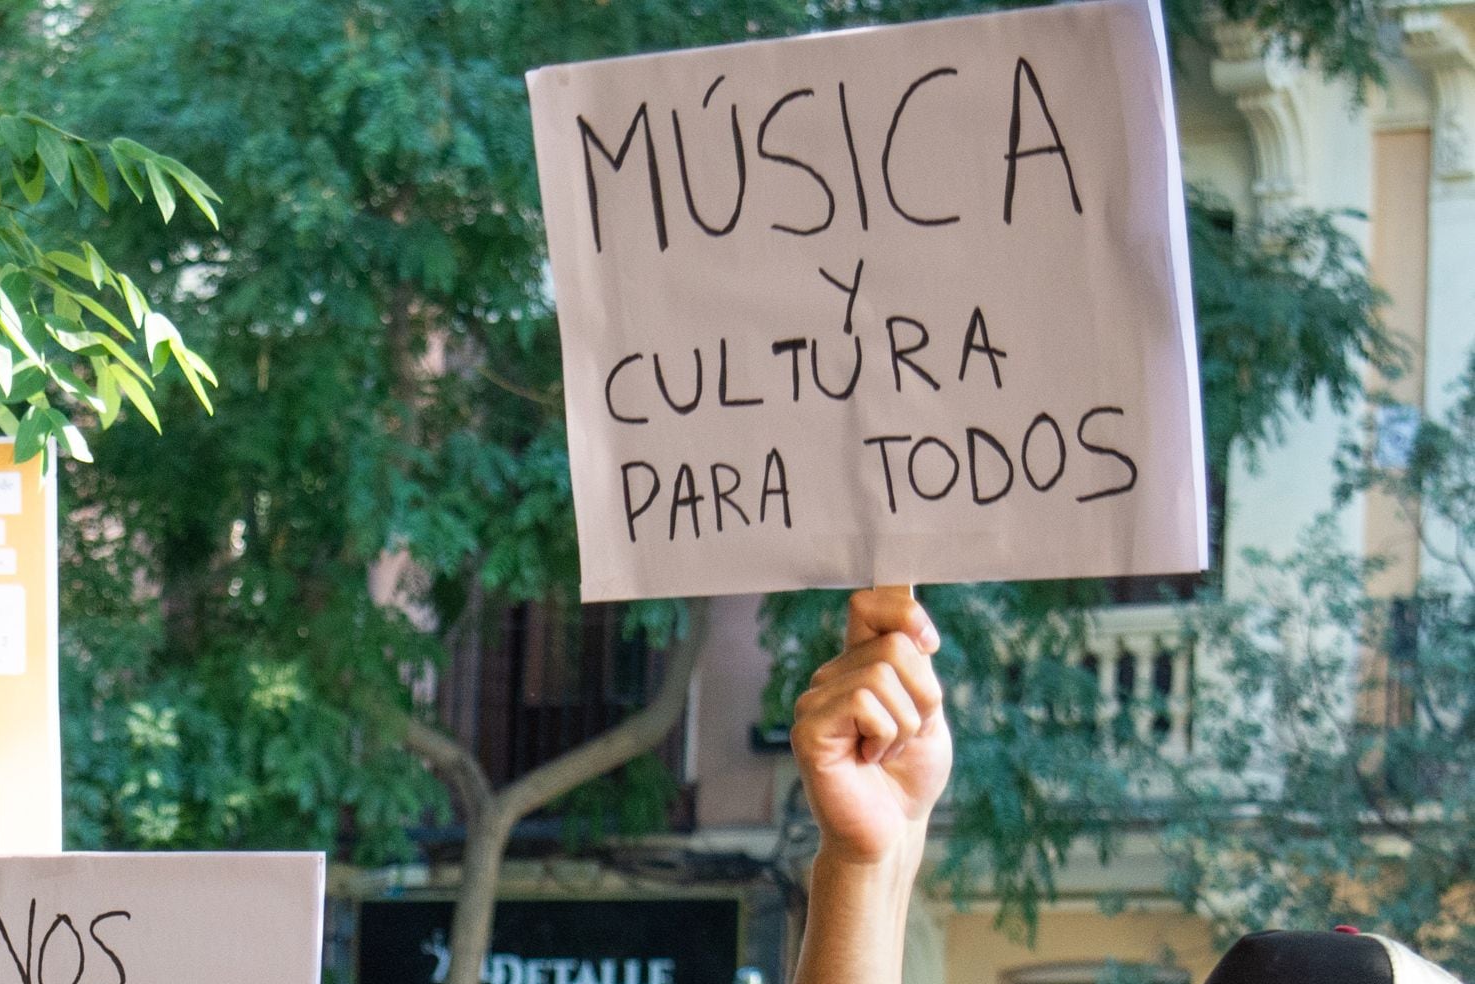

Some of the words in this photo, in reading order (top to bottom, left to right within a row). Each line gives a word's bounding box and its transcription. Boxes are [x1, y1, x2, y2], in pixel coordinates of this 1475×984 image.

[575, 56, 1085, 254] MÚSICA
[817, 257, 864, 334] Y
[605, 306, 1007, 425] CULTURA
[620, 446, 793, 543] PARA
[862, 405, 1140, 514] TODOS
